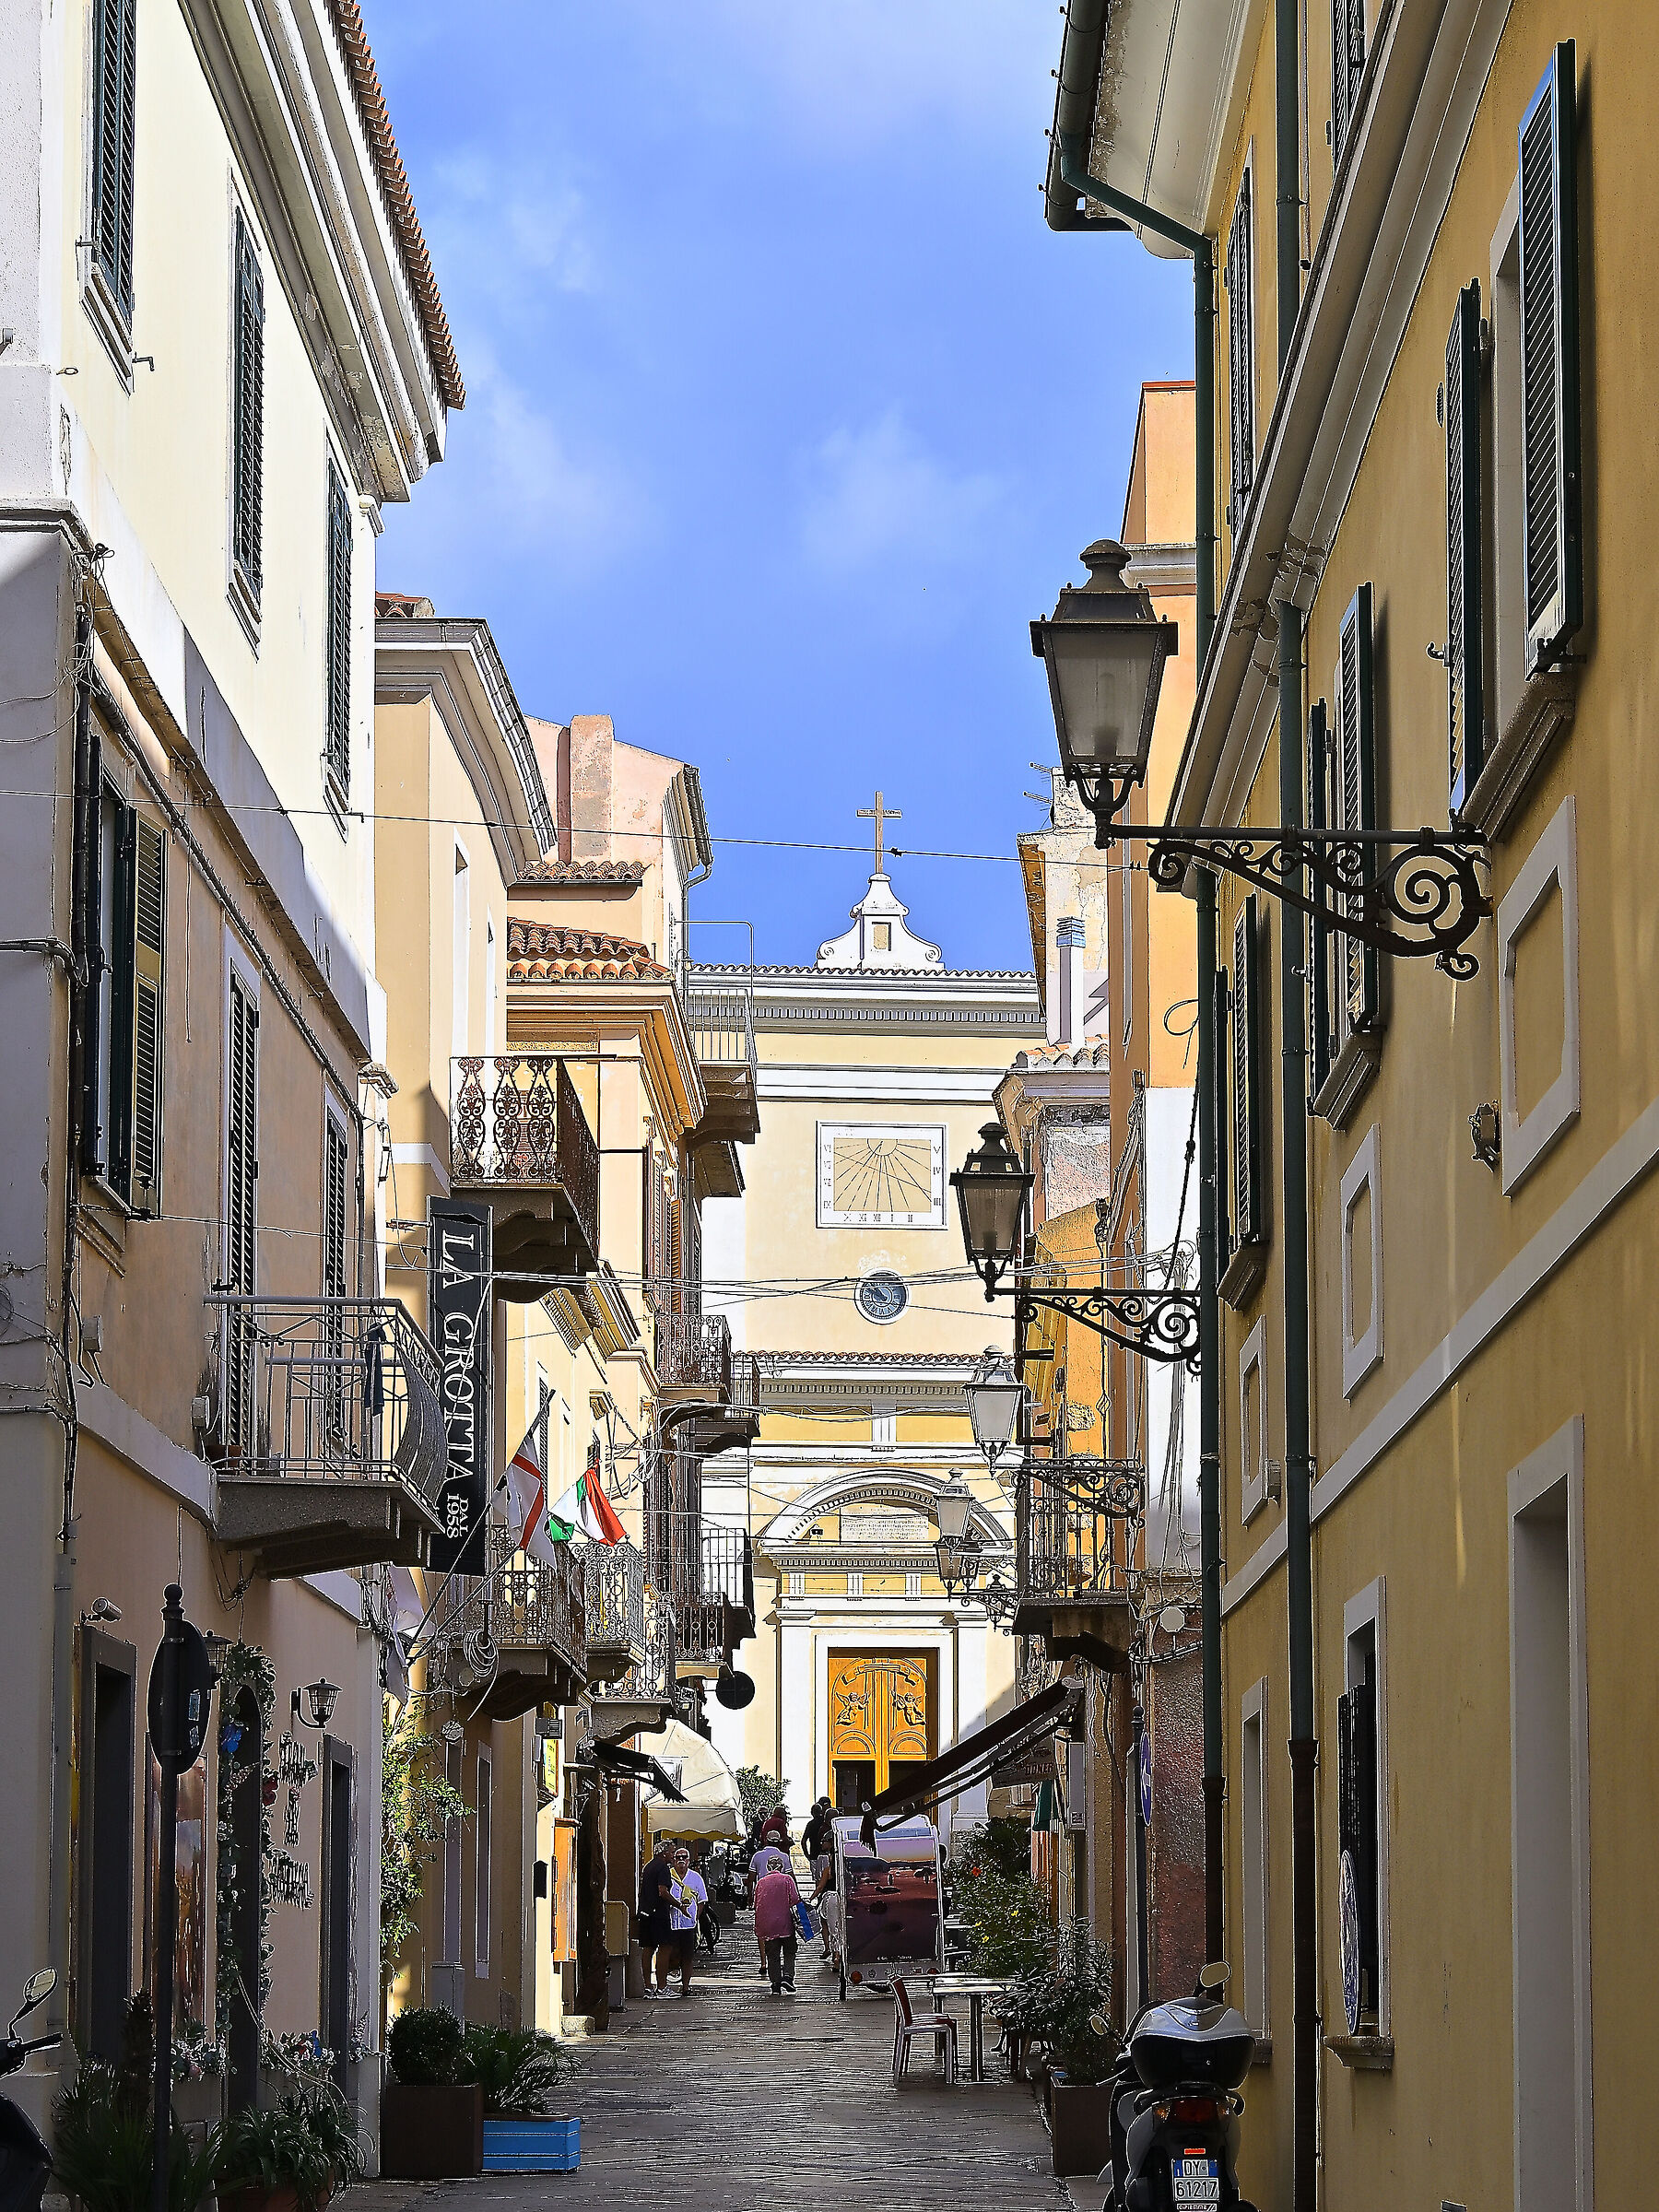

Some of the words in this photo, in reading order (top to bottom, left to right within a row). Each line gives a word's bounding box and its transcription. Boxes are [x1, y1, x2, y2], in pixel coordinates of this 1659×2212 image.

[442, 1230, 475, 1289] LA
[443, 1312, 475, 1483] GROTTA
[446, 1492, 459, 1539] 1958
[459, 1498, 469, 1537] DAL
[1175, 2181, 1218, 2197] 61217
[1183, 2160, 1200, 2176] DY
